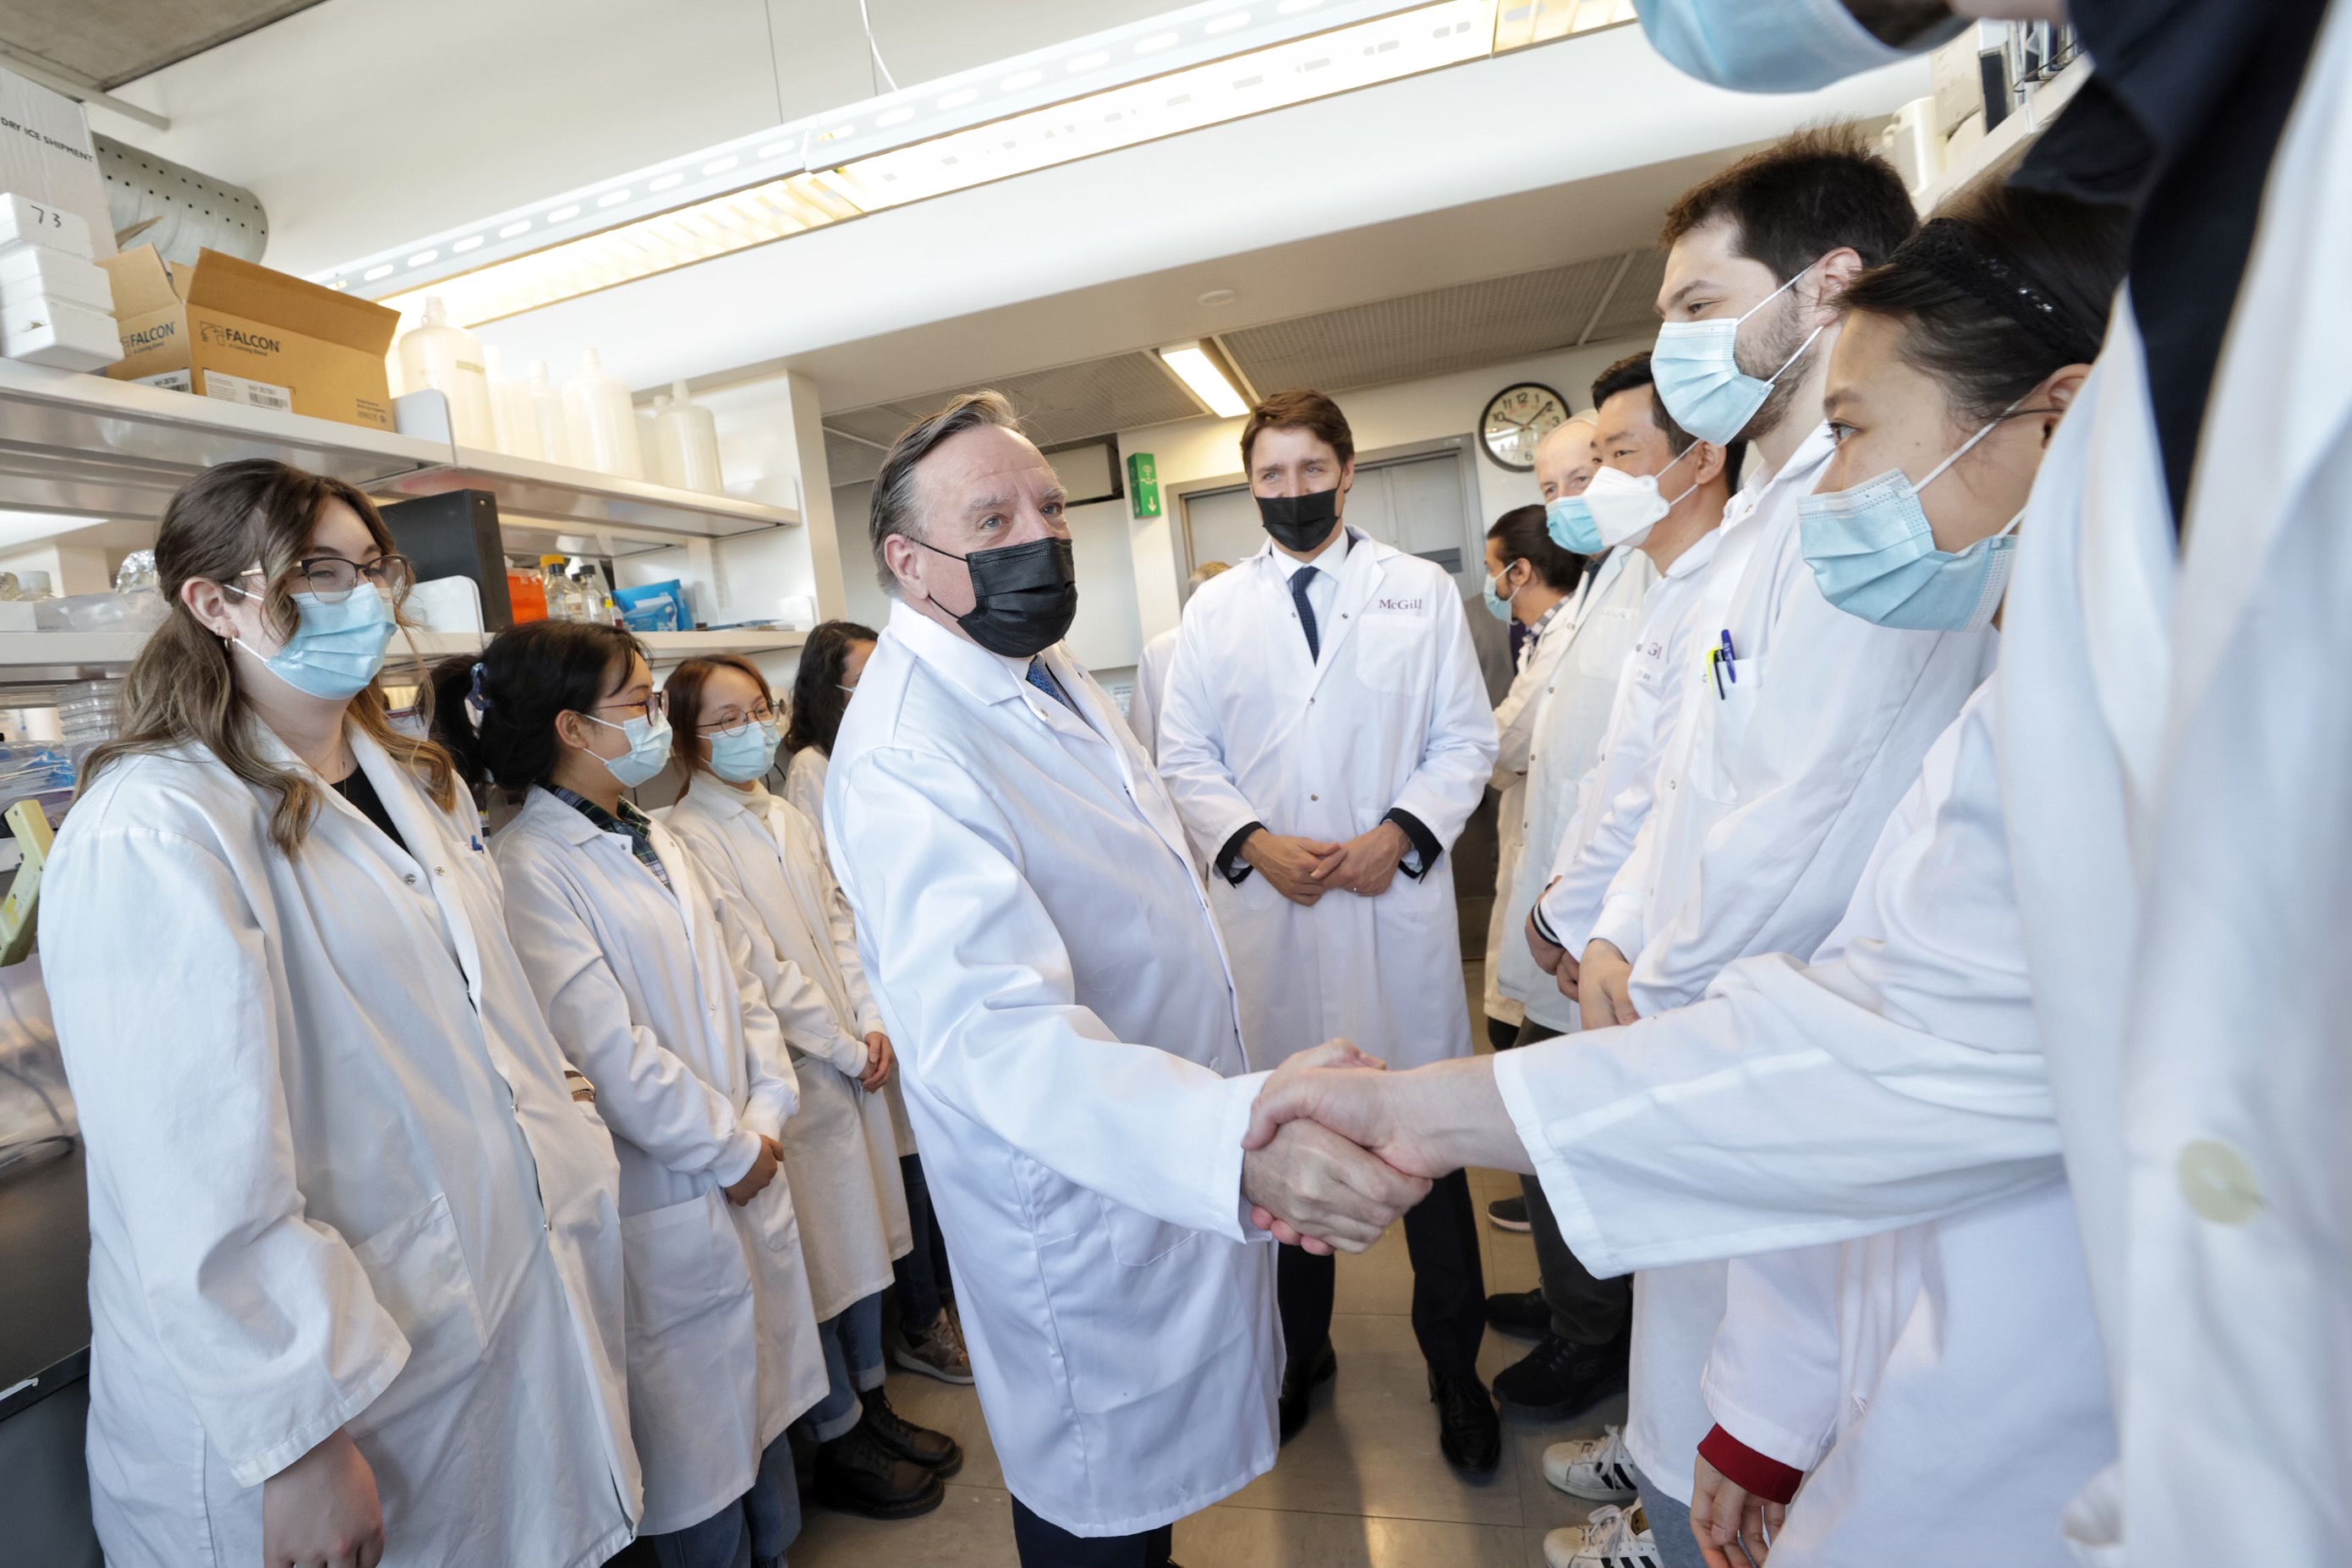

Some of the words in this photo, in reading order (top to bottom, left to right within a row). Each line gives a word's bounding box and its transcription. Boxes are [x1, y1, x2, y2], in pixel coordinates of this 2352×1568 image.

[0, 117, 20, 131] DRY
[24, 127, 41, 141] ICE
[43, 135, 94, 162] SHIPMENT
[129, 323, 174, 348] FALCON
[225, 328, 279, 353] FALCON
[1516, 392, 1528, 403] 12
[1534, 393, 1539, 403] 1
[1502, 398, 1512, 409] 11
[1493, 411, 1505, 422] 10
[1378, 599, 1422, 610] McGill
